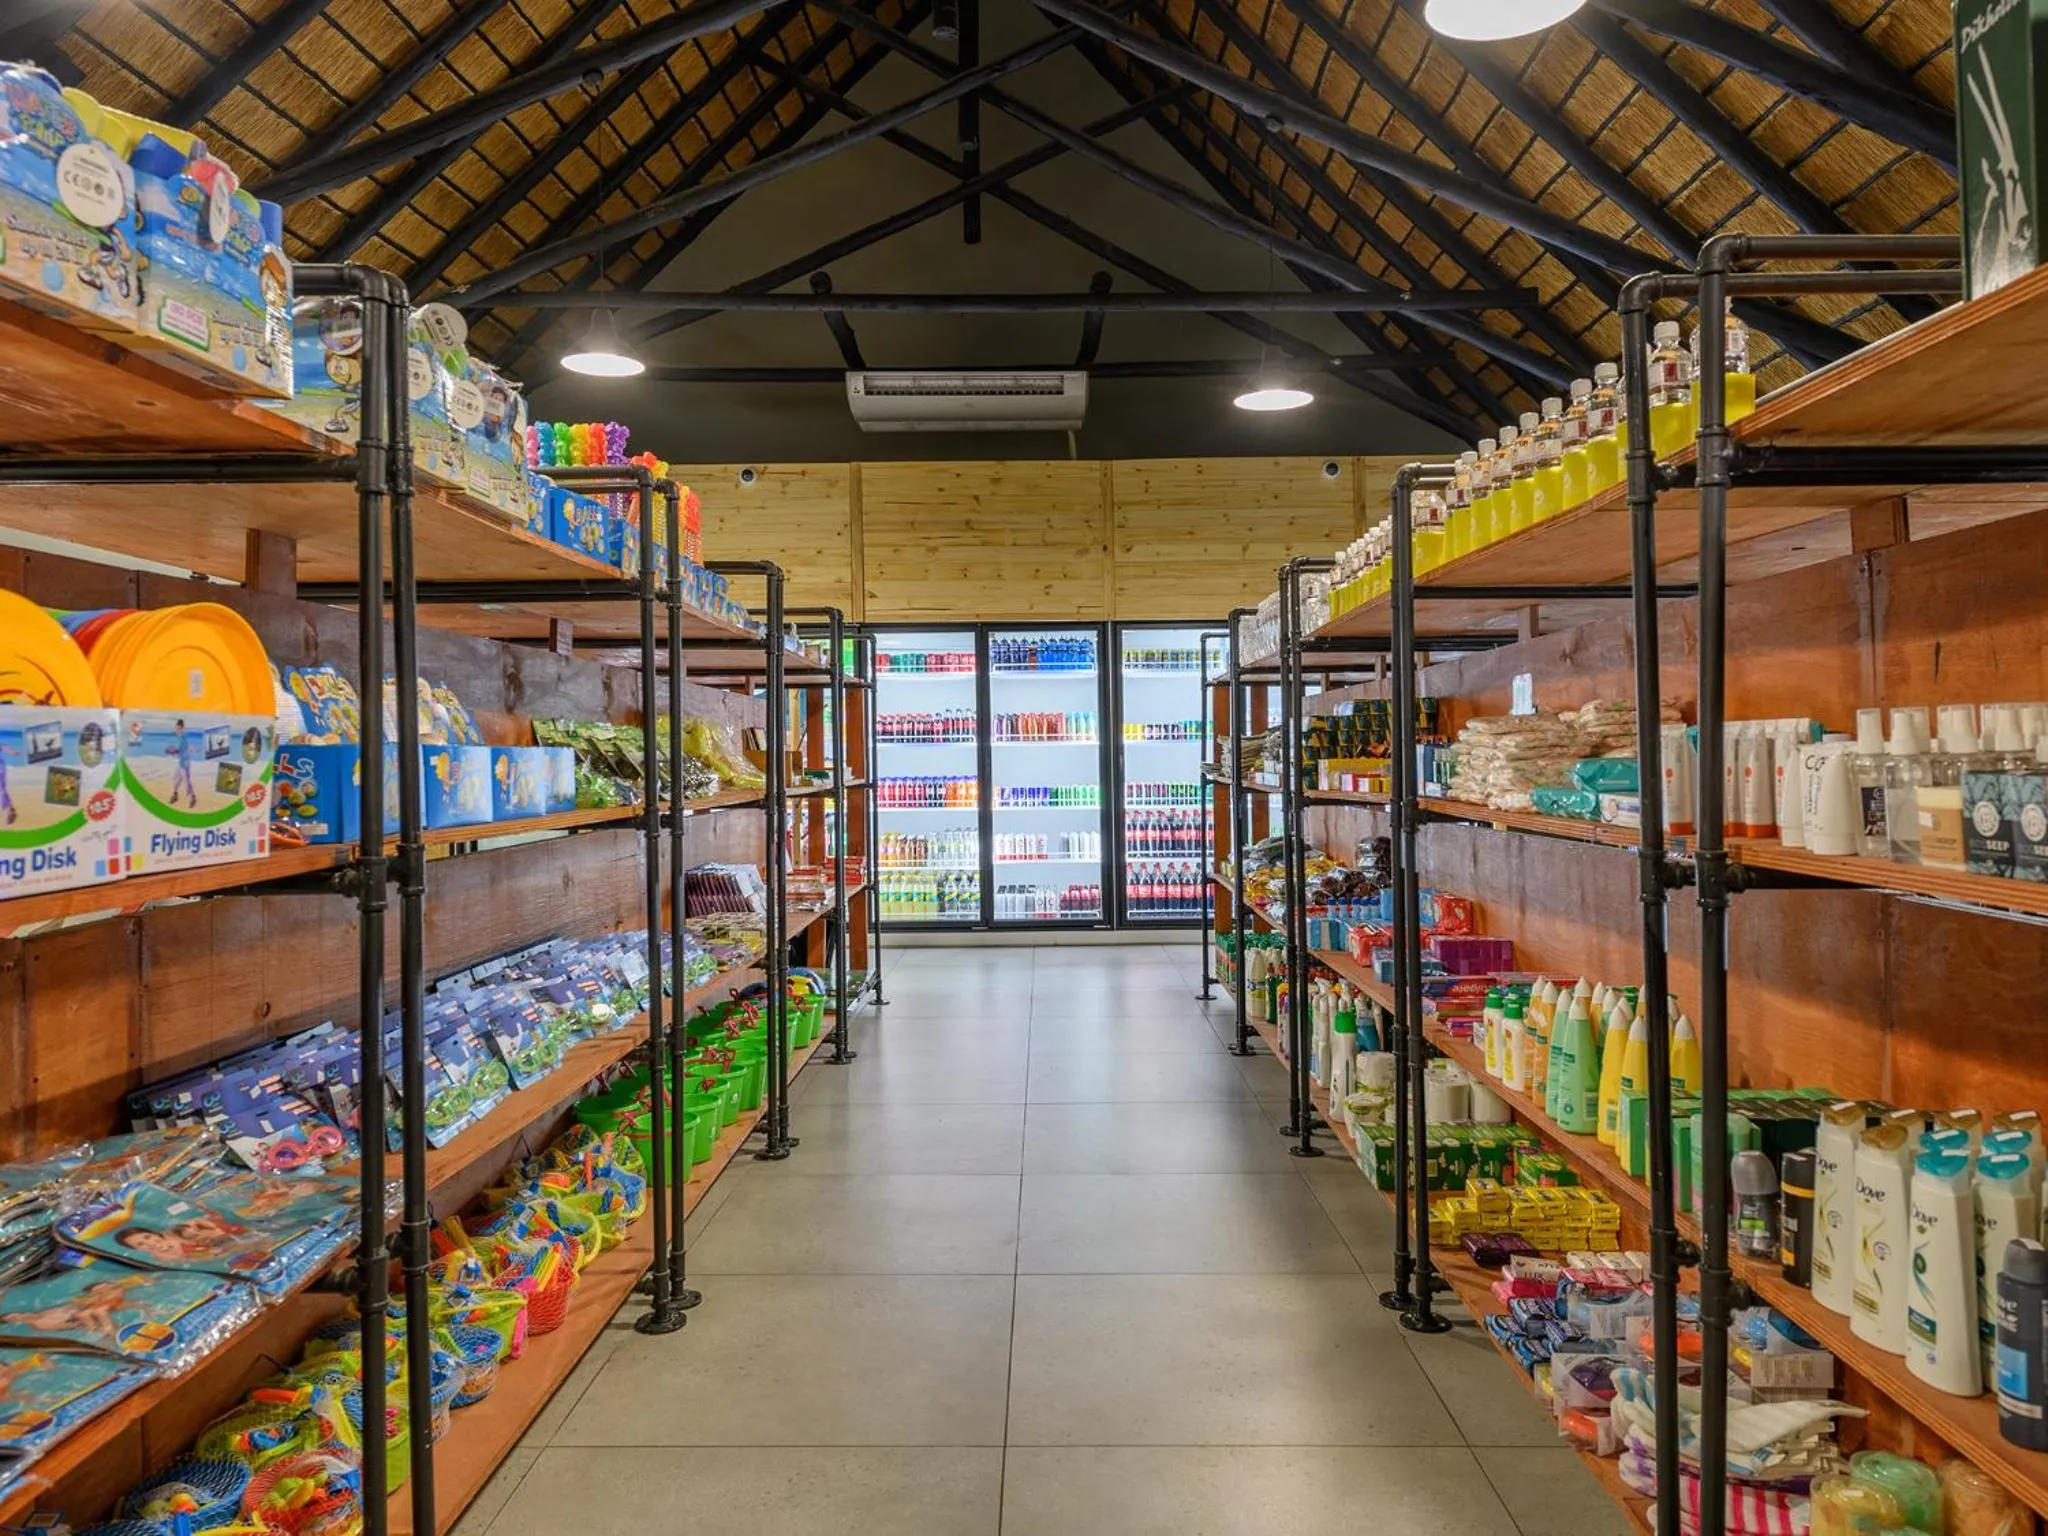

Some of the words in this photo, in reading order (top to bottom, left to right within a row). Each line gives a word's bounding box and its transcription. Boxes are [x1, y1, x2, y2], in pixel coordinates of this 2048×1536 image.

[150, 831, 201, 856] Flying
[204, 829, 237, 849] Disk
[31, 847, 77, 871] Disk
[1856, 1176, 1886, 1202] Dove
